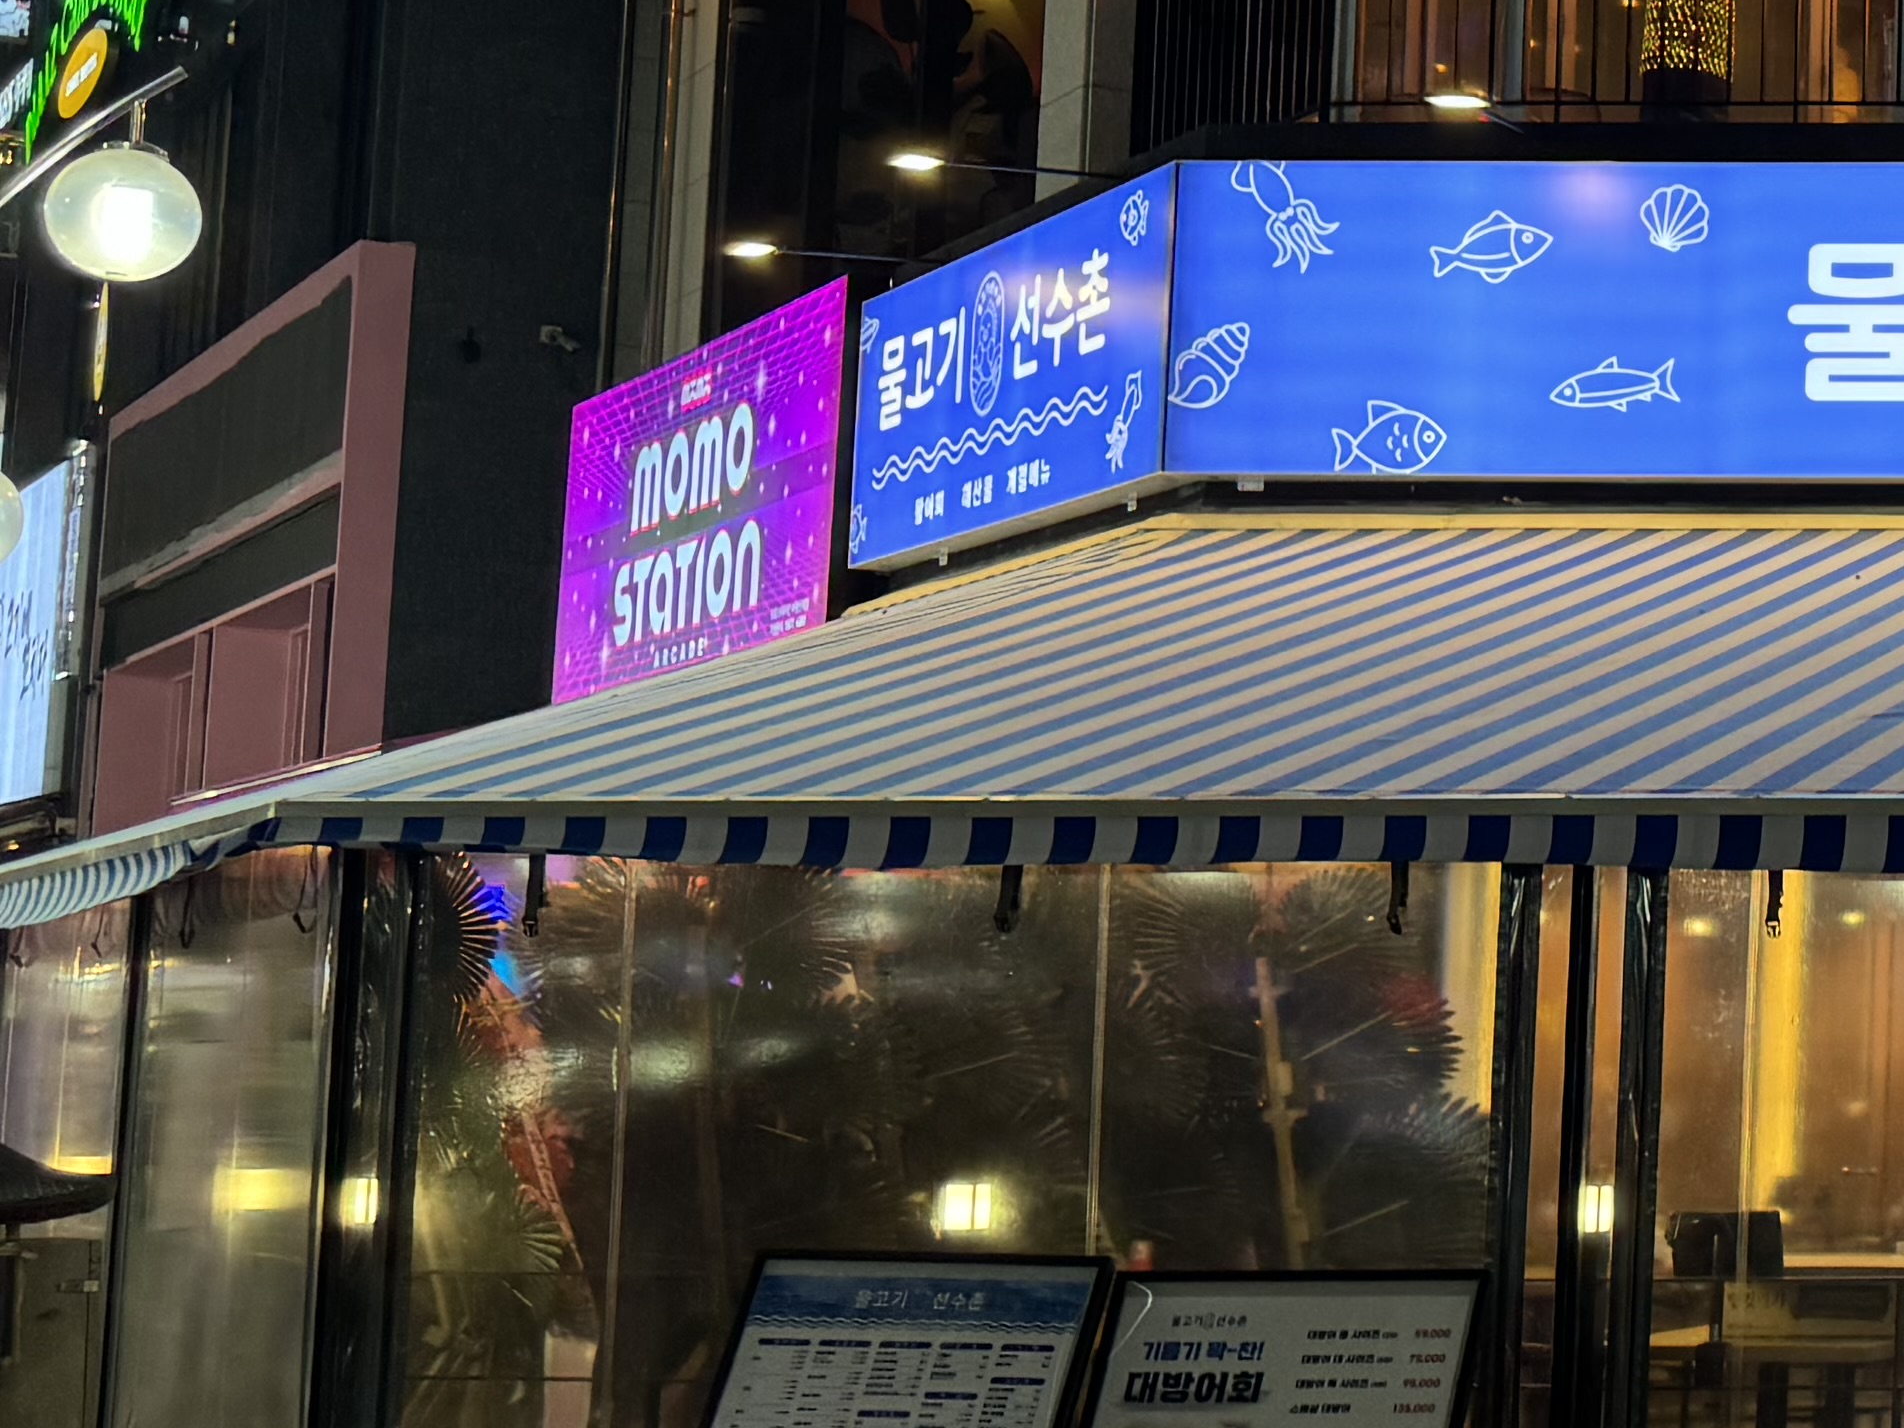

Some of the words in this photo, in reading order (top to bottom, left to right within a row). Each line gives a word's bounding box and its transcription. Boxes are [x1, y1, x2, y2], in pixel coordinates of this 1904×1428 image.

[877, 307, 967, 432] 물고기
[1010, 248, 1111, 380] 선수촌
[653, 636, 706, 669] ARCADE
[1123, 1371, 1266, 1403] 대방어회
